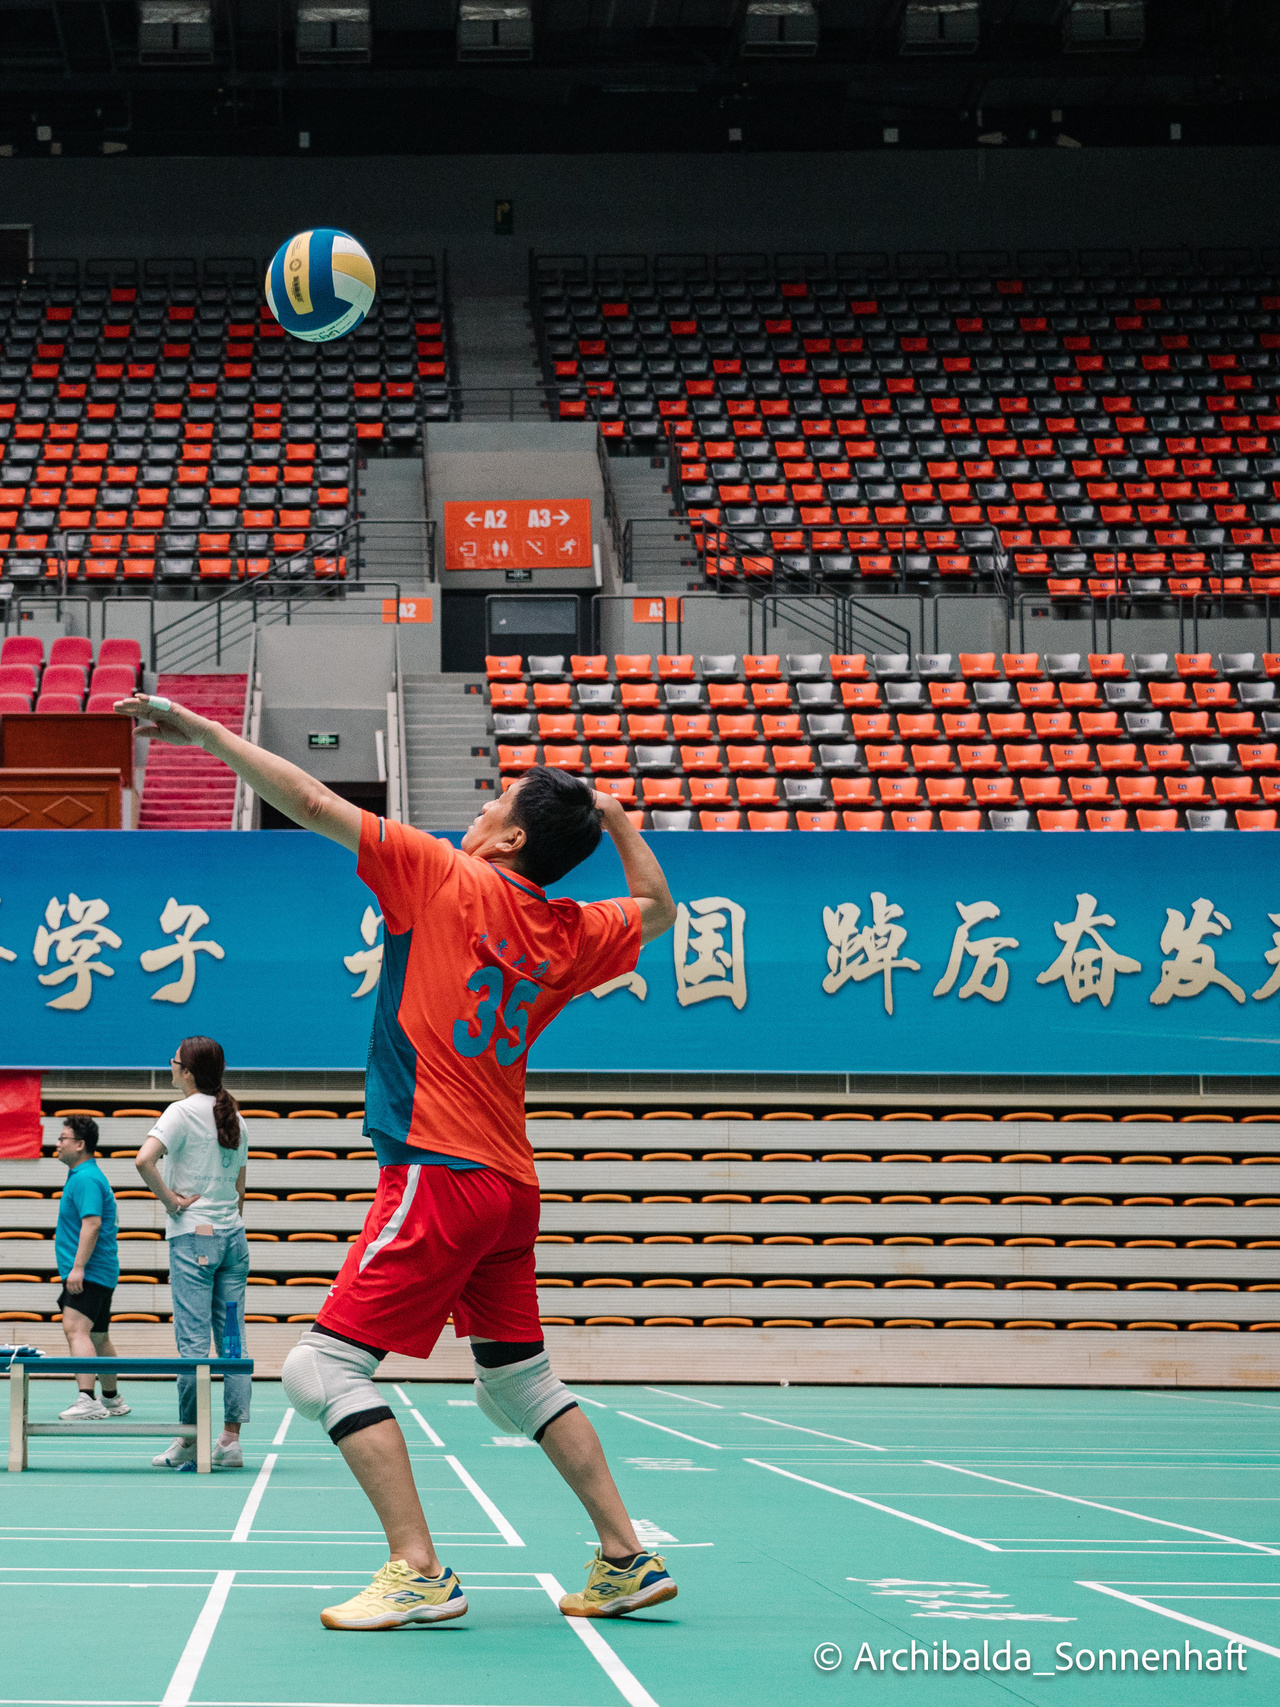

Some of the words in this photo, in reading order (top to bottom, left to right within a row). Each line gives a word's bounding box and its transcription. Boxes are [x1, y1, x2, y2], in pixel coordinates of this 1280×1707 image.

[483, 509, 508, 529] A2
[528, 508, 552, 528] A3
[399, 602, 417, 618] A2
[452, 965, 544, 1067] 35
